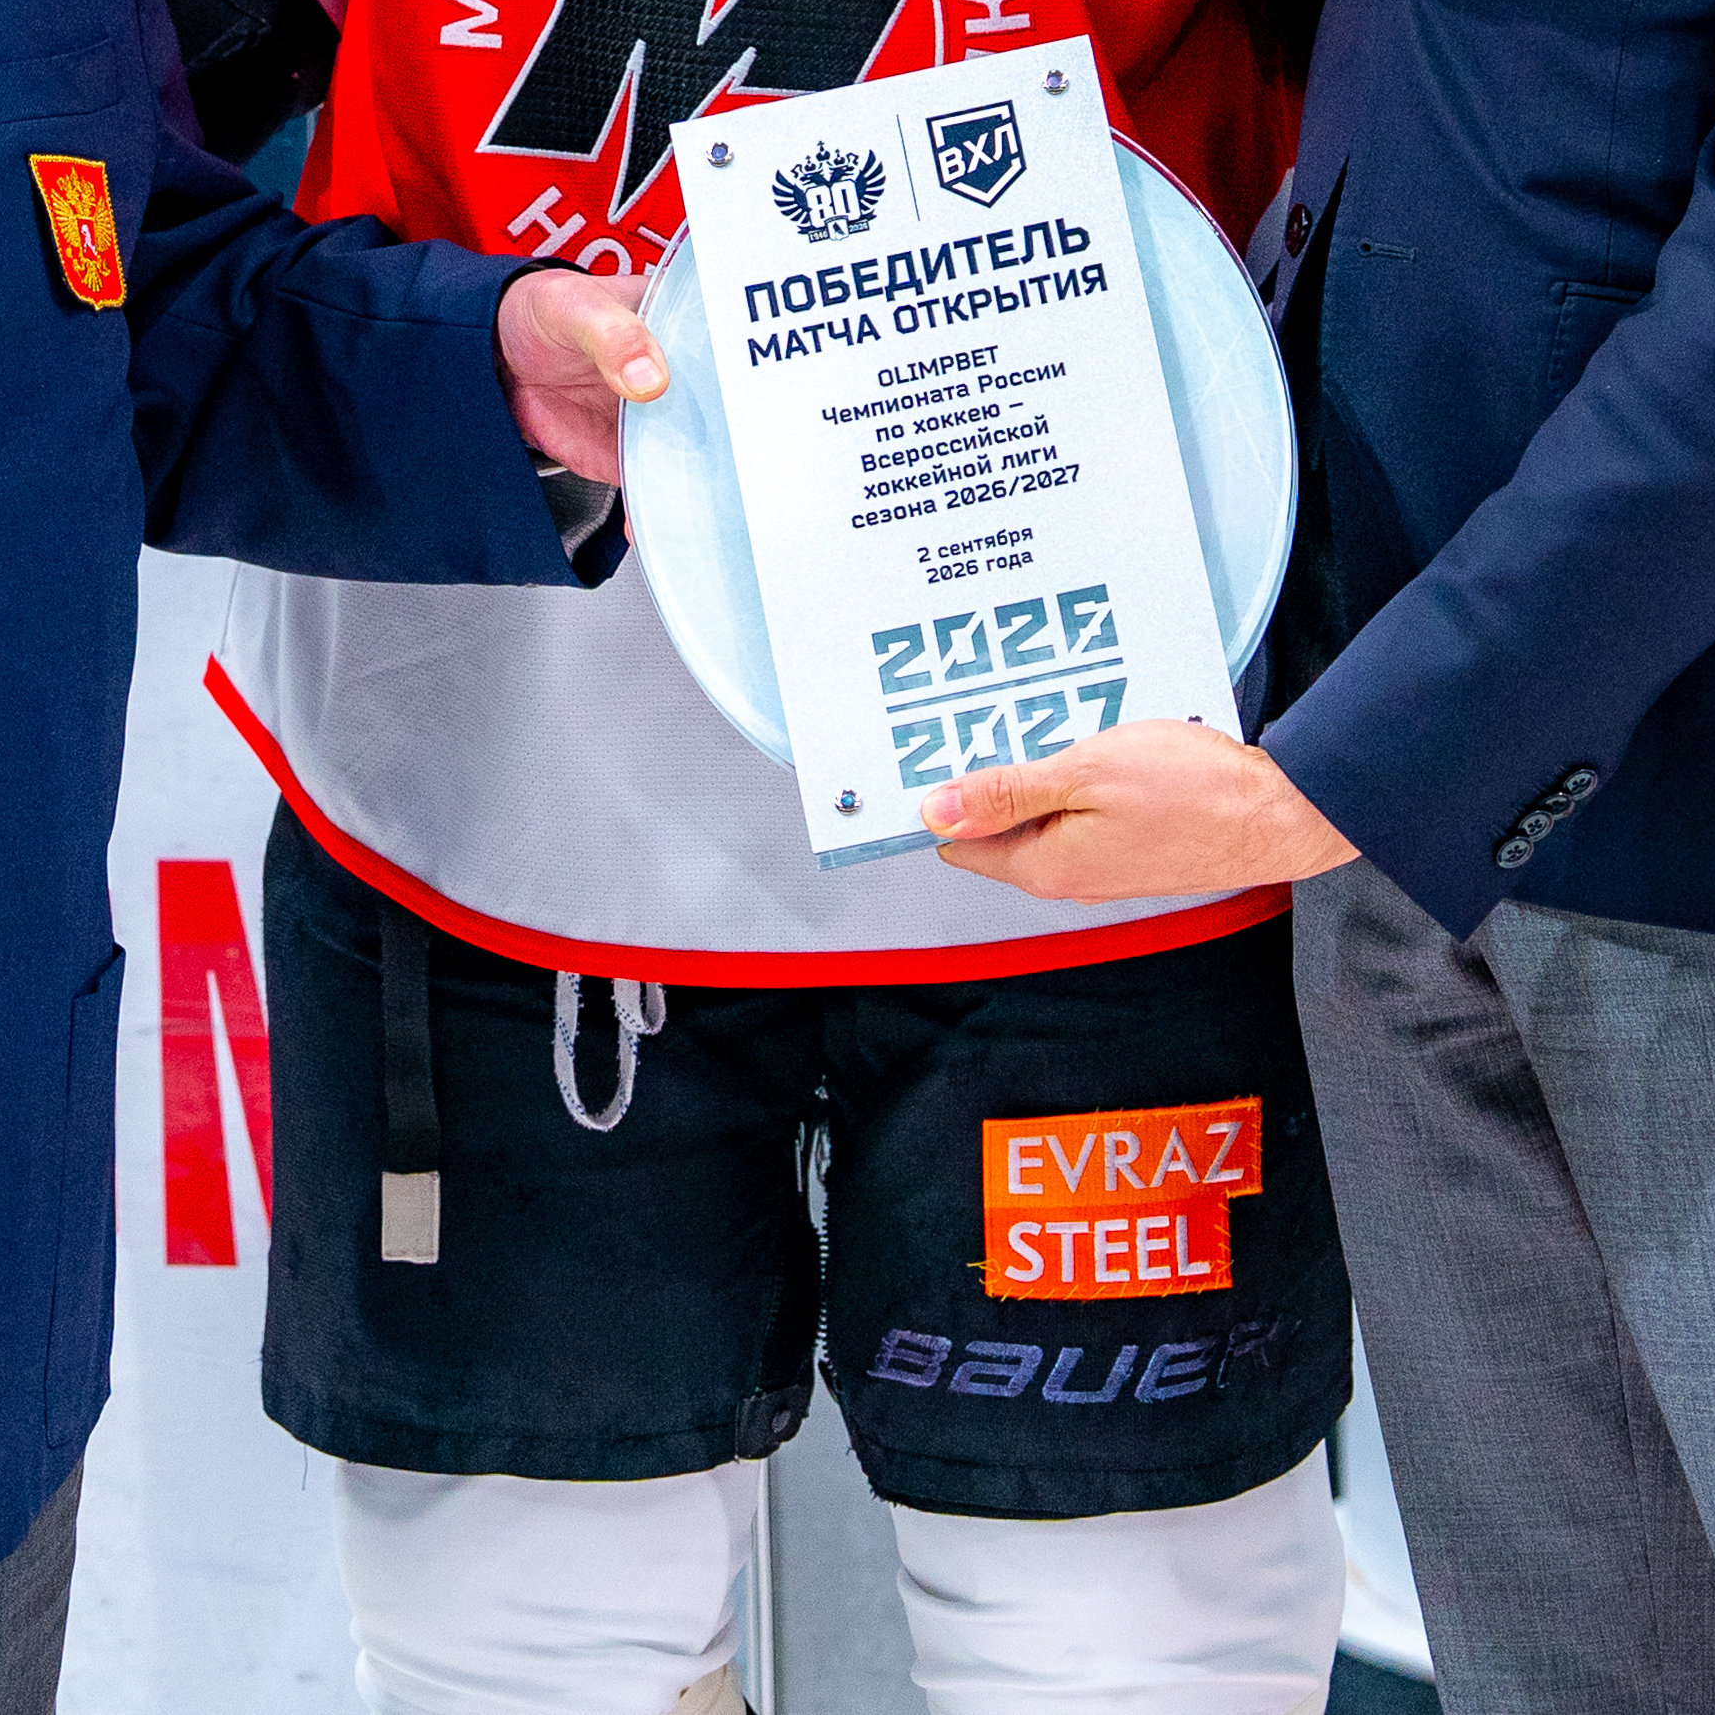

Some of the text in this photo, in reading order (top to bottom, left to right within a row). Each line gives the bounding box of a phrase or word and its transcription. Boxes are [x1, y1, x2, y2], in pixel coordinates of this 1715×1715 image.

[937, 121, 1020, 185] ВХЛ
[744, 217, 1092, 323] ПОБЕДИТЕЛЬ
[747, 262, 1109, 367] МАТЧА ОТКРЫТИЯ
[821, 361, 1067, 425] Чемпионата России
[877, 345, 1000, 388] OLIMPBET
[860, 413, 1050, 473] Всероссийской
[875, 423, 905, 443] по
[912, 402, 1001, 435] хоккею
[850, 463, 1081, 530] сезона 2026/2027
[863, 444, 1058, 500] хоккейной лиги
[916, 527, 1034, 564] 2 сентября
[926, 550, 1034, 585] 2026 года
[871, 583, 1120, 696] 2026
[1006, 1119, 1245, 1196] EVRAZ
[1004, 1213, 1211, 1284] STEEL
